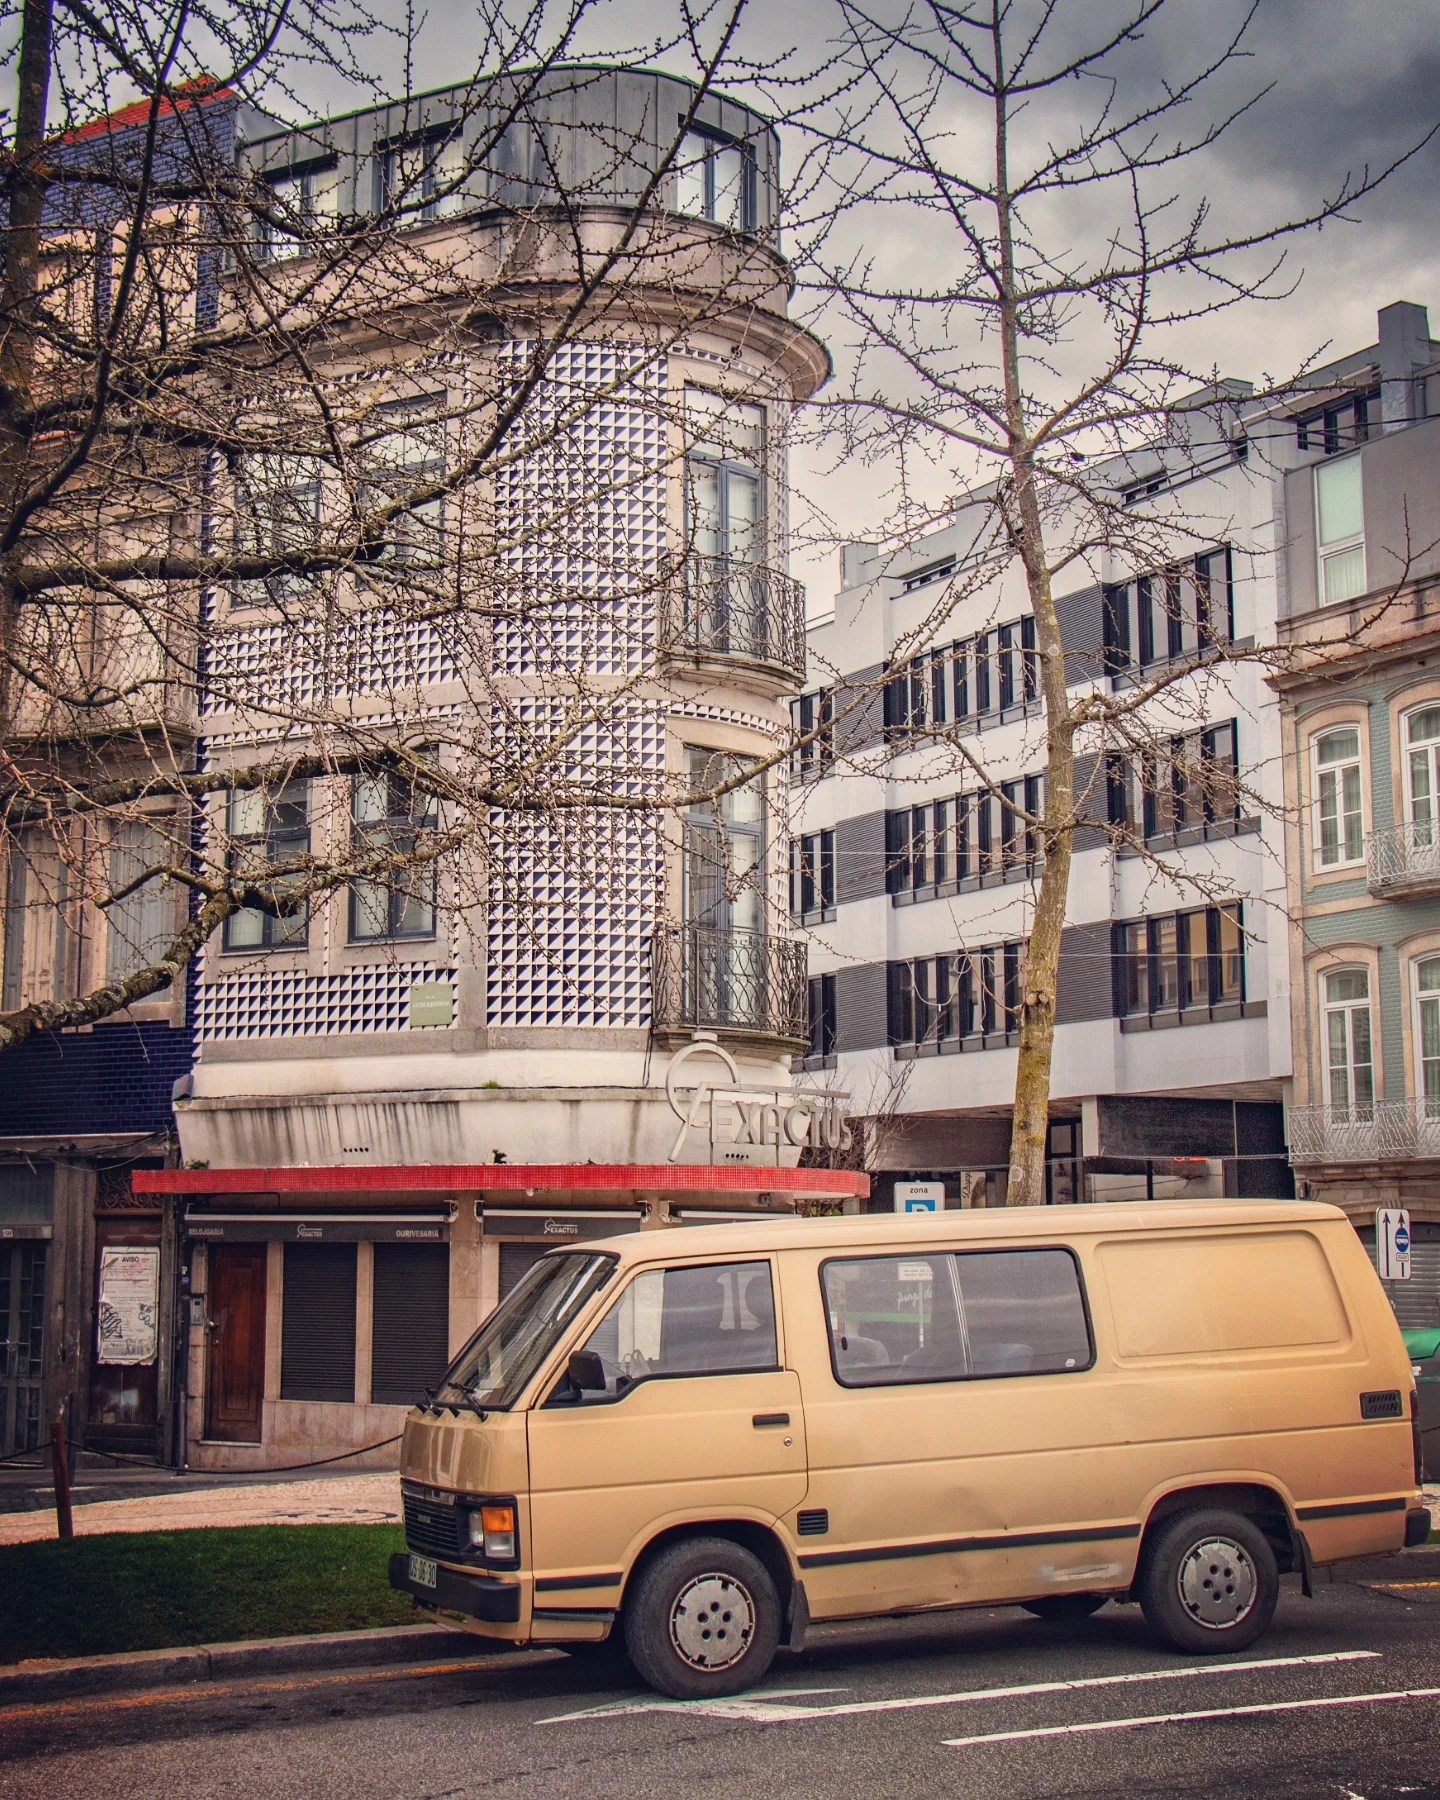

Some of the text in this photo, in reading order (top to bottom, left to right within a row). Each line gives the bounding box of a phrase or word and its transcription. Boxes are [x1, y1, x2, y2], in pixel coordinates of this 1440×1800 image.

[711, 1100, 851, 1150] EXACTUS
[301, 1230, 323, 1238] EXACTUS
[395, 1229, 439, 1238] OURIVESARIA
[550, 1226, 579, 1234] EXACTUS
